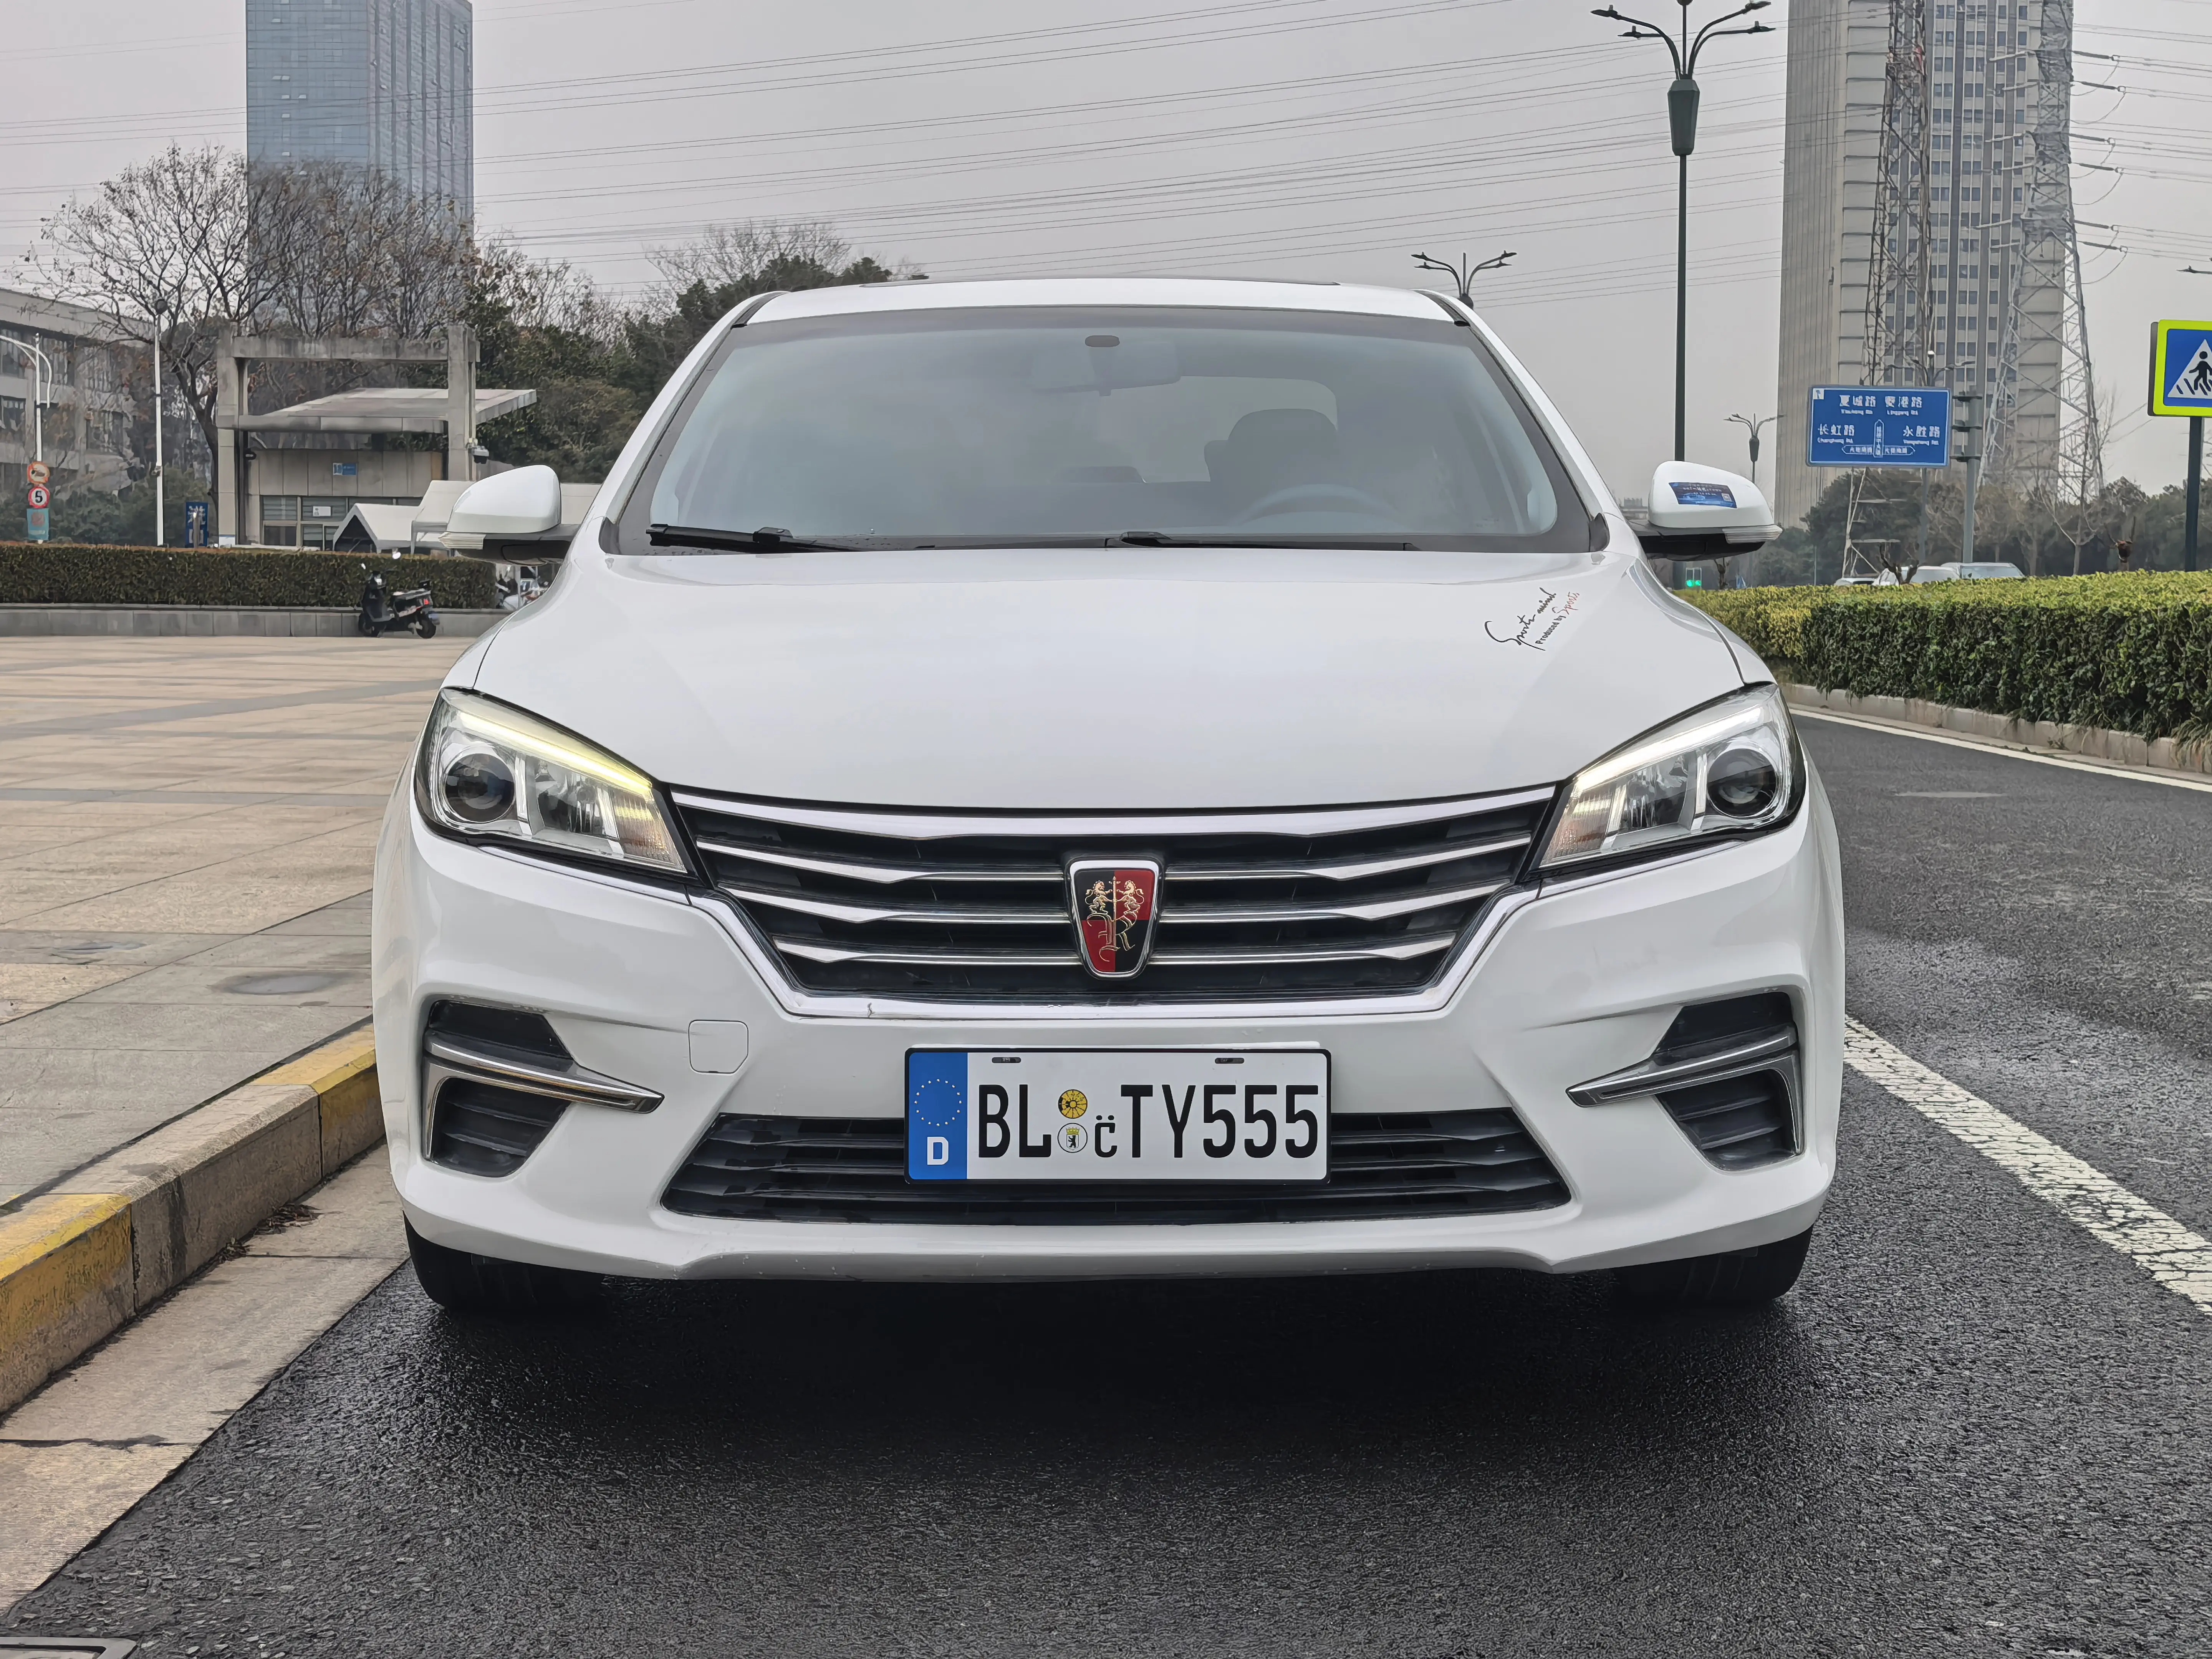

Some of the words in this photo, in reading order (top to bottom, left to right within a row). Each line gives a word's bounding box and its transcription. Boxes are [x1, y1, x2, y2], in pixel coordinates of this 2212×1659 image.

[35, 490, 43, 503] 5
[1535, 622, 1560, 644] Produced
[927, 1136, 949, 1165] D
